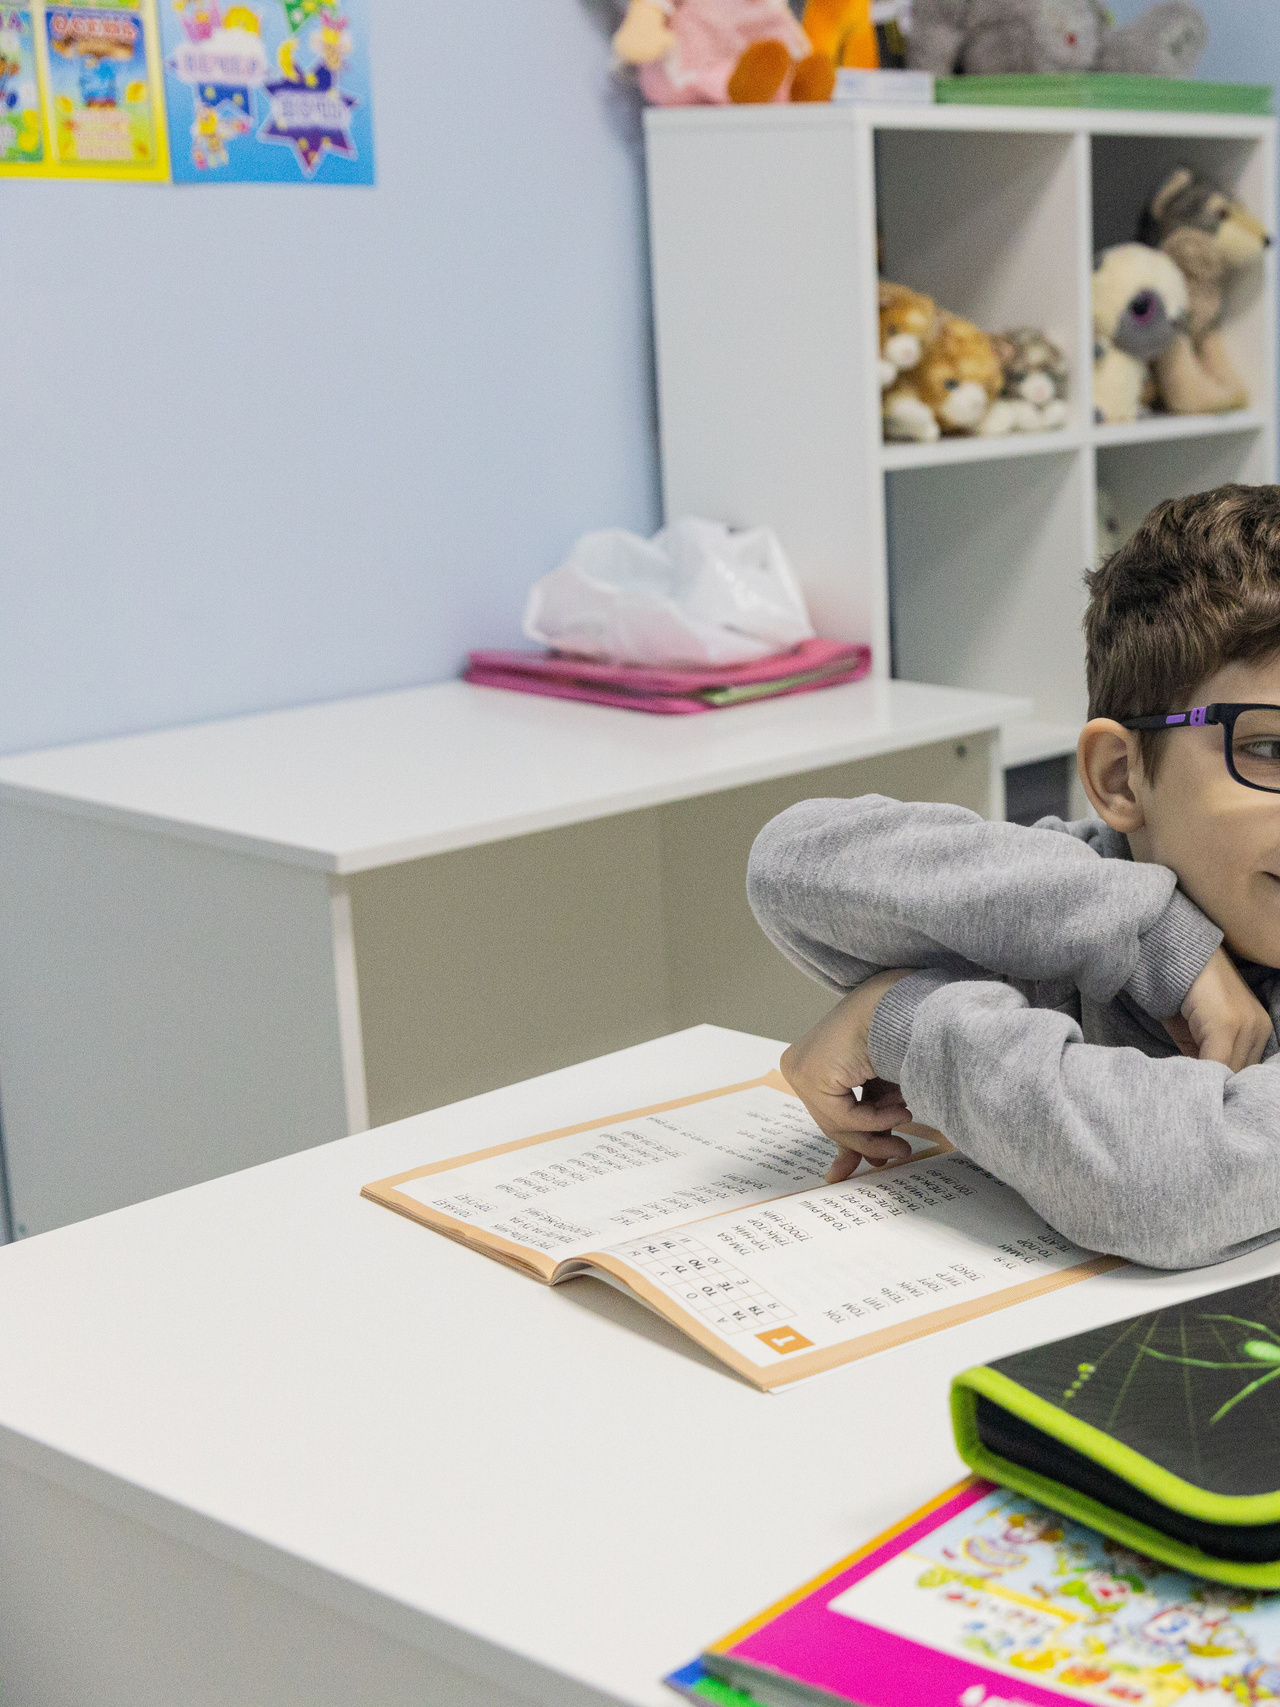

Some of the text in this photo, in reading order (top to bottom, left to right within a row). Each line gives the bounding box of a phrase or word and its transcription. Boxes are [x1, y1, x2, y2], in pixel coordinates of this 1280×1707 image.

[686, 1259, 708, 1270] ТЮ
[704, 1256, 723, 1265] Ю
[935, 1271, 963, 1287] ТИГР
[948, 1263, 982, 1282] ТЕКСТ
[643, 1244, 750, 1320] ТА ТО ТУ ТЫ
[714, 1281, 736, 1292] ТЁ
[917, 1277, 945, 1292] ТОРТ
[877, 1287, 907, 1304] ТЕНЬ
[896, 1281, 926, 1298] ТАНК
[747, 1305, 767, 1316] ТЯ
[841, 1302, 867, 1317] ТОМ
[862, 1297, 888, 1310] ТИП
[822, 1309, 848, 1323] ТОК
[769, 1333, 800, 1347] Т
